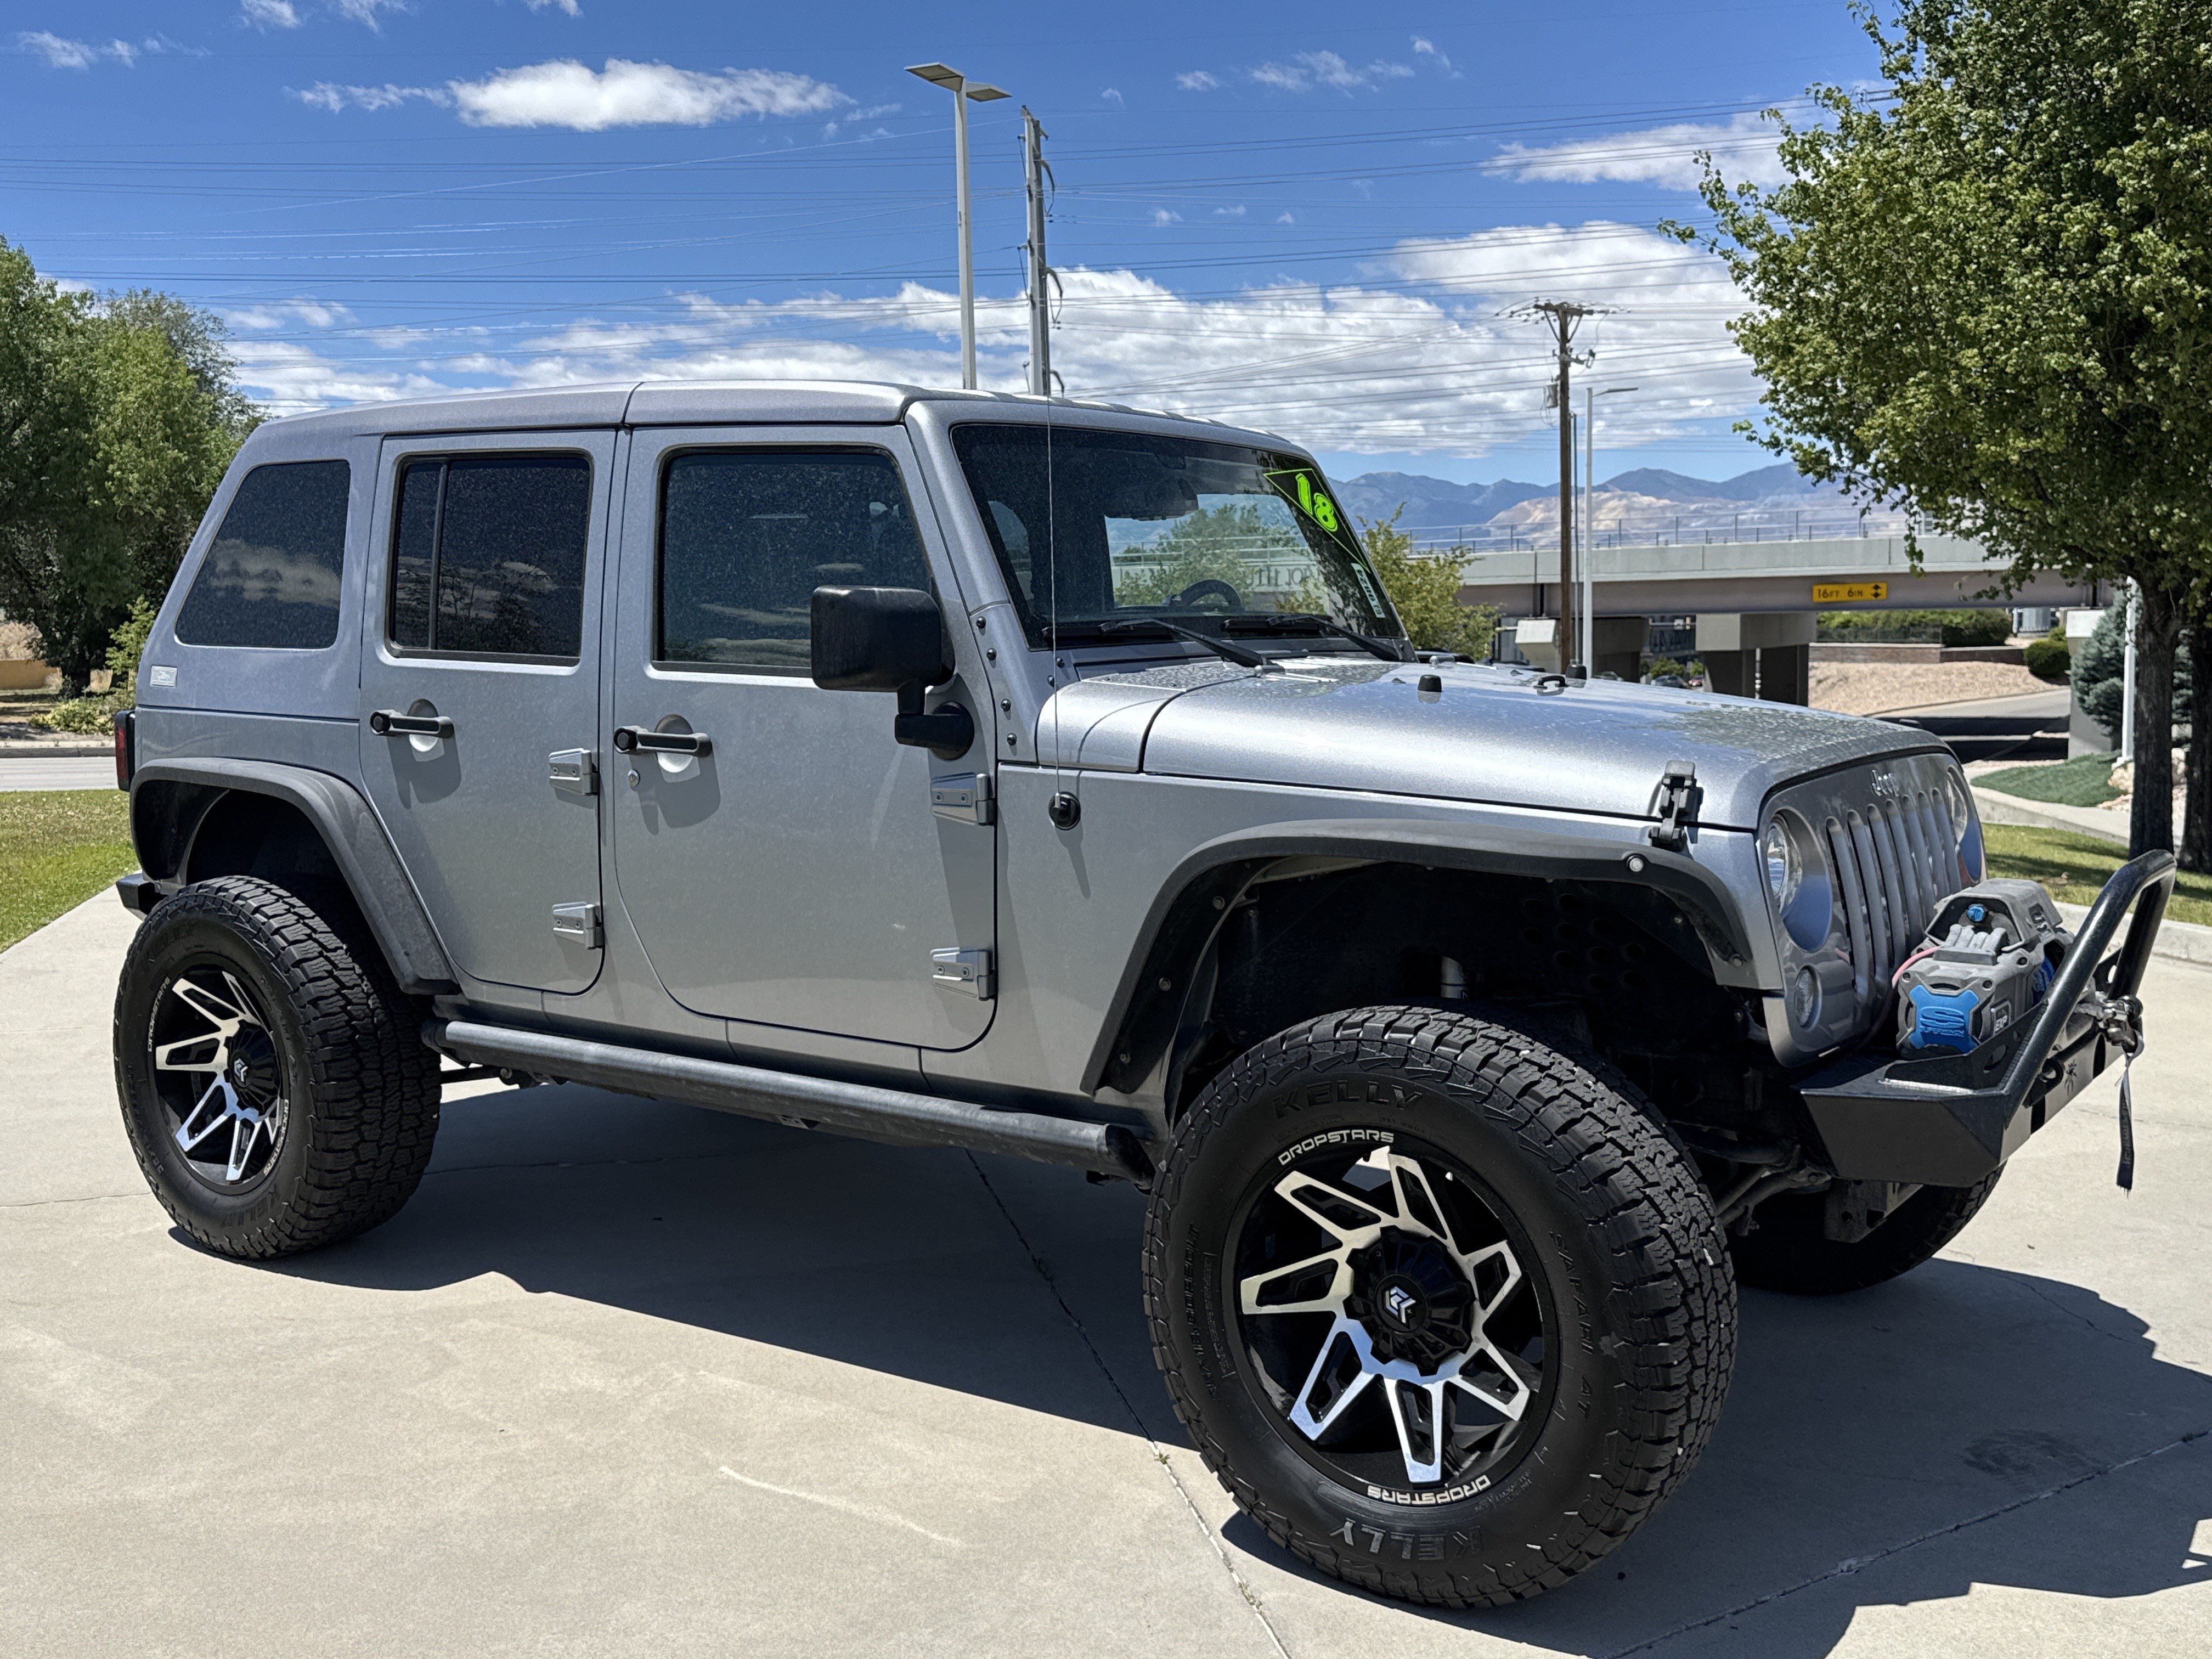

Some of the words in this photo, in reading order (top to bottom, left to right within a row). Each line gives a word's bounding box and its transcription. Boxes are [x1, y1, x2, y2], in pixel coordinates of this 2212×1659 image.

[1272, 1080, 1423, 1119] KELLY
[1278, 1129, 1395, 1166] DROPSTARS
[1551, 1231, 1592, 1357] SAFARI
[1367, 1474, 1491, 1504] DROPSTARS
[1329, 1517, 1482, 1561] KELLY
